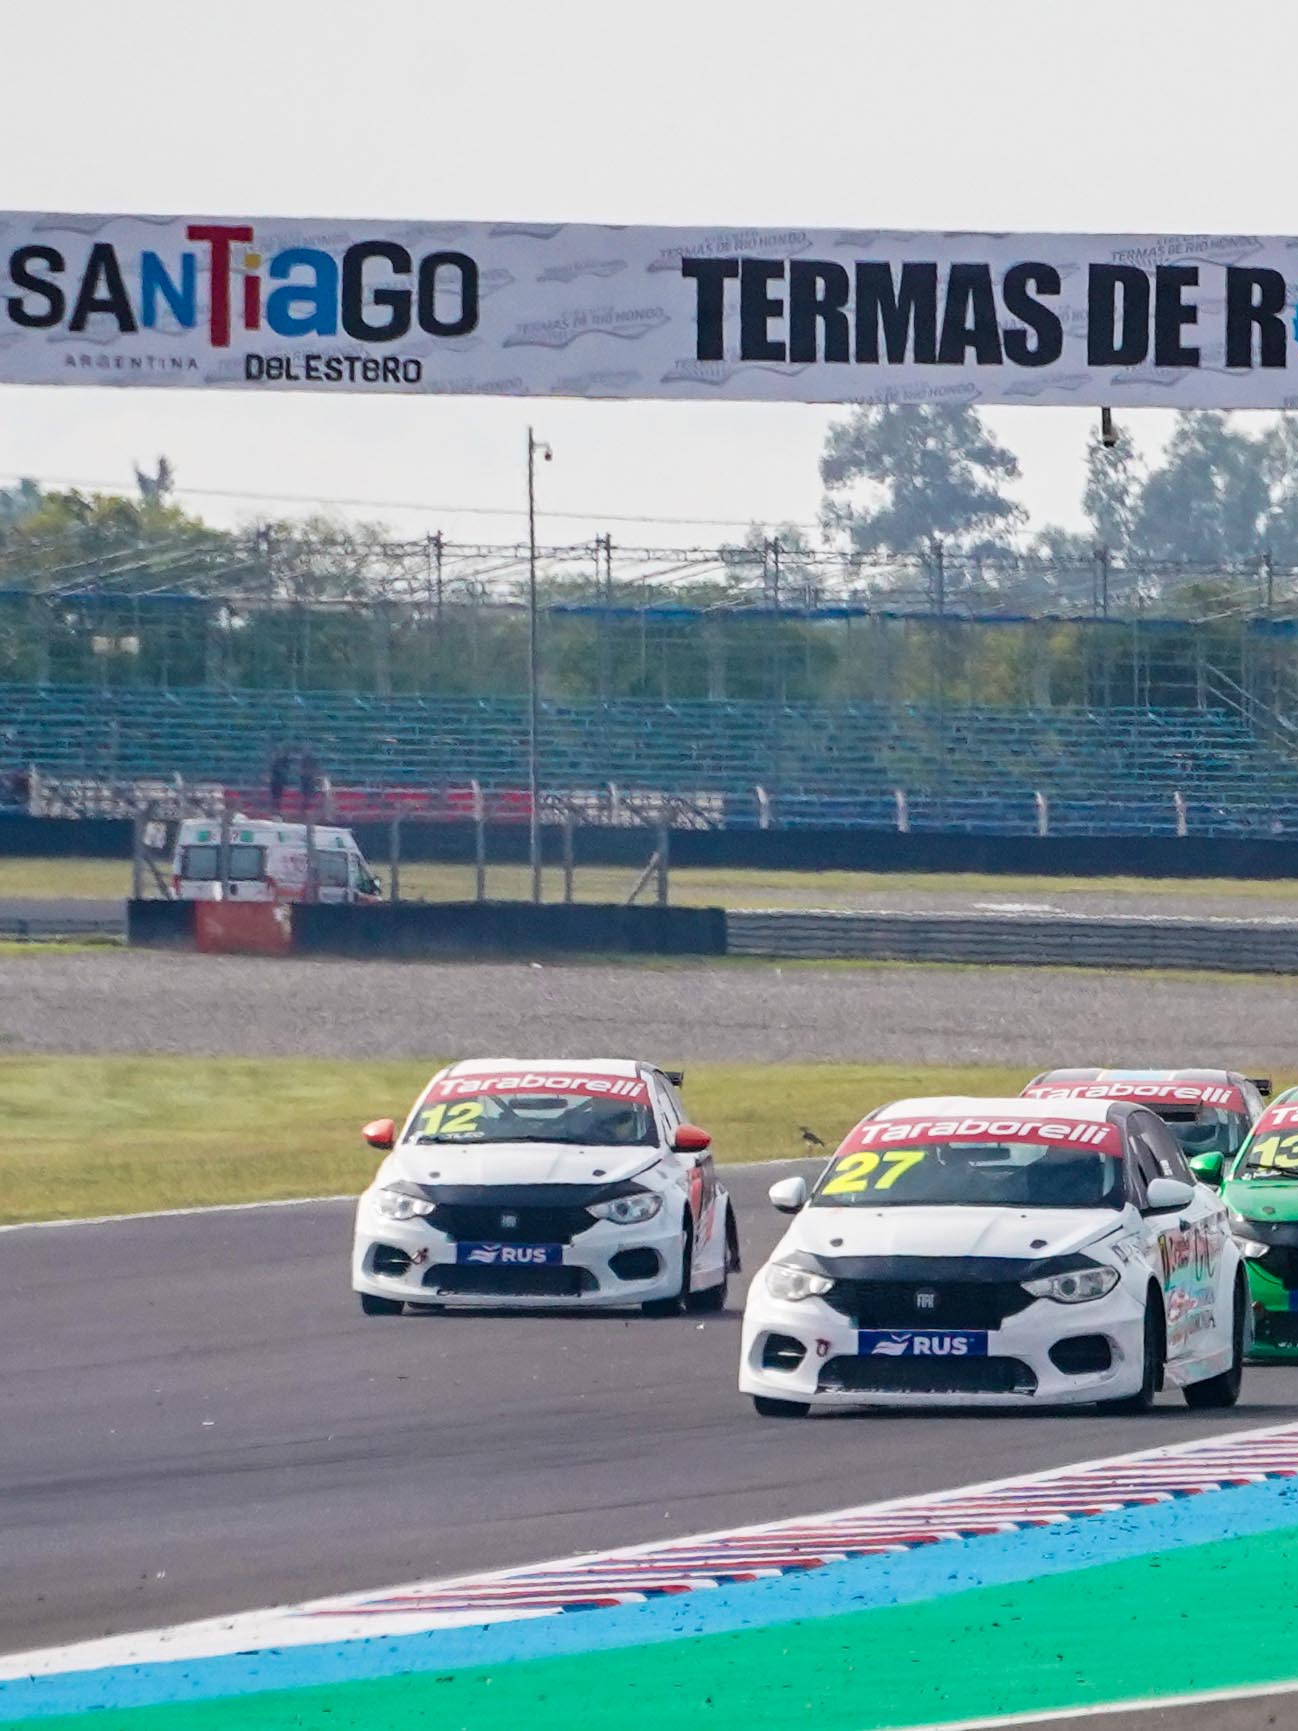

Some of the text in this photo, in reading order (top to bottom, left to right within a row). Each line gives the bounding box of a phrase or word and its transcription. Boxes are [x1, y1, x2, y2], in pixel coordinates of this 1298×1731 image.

[682, 257, 1062, 367] TERMAS
[1087, 263, 1200, 368] DE
[65, 354, 198, 369] ARGENTINA
[439, 1073, 646, 1098] Taraborelli
[420, 1101, 485, 1135] 12
[861, 1119, 1111, 1146] Taraborelli
[821, 1150, 928, 1196] 27
[501, 1247, 548, 1265] RUS
[912, 1336, 969, 1356] RUS
